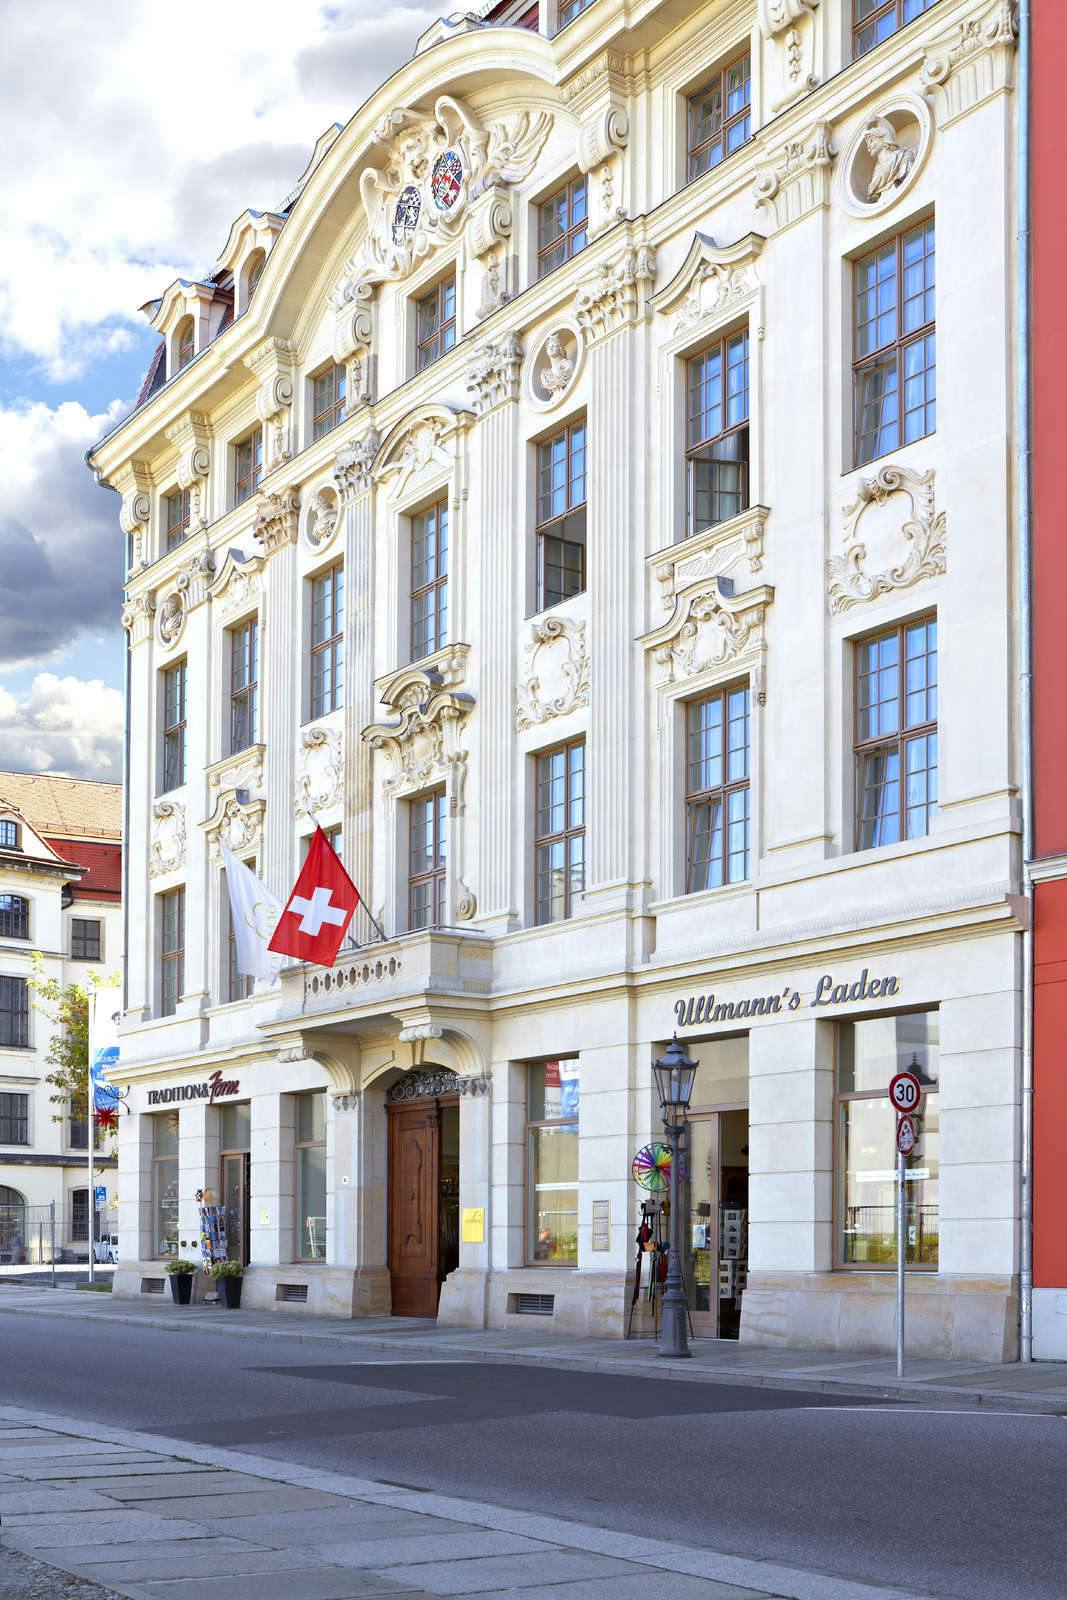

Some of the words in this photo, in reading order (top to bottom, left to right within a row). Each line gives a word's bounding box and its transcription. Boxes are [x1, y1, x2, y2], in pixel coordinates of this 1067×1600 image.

[674, 987, 801, 1027] Ullmann's
[811, 968, 899, 1007] Laden
[896, 1084, 914, 1102] 30
